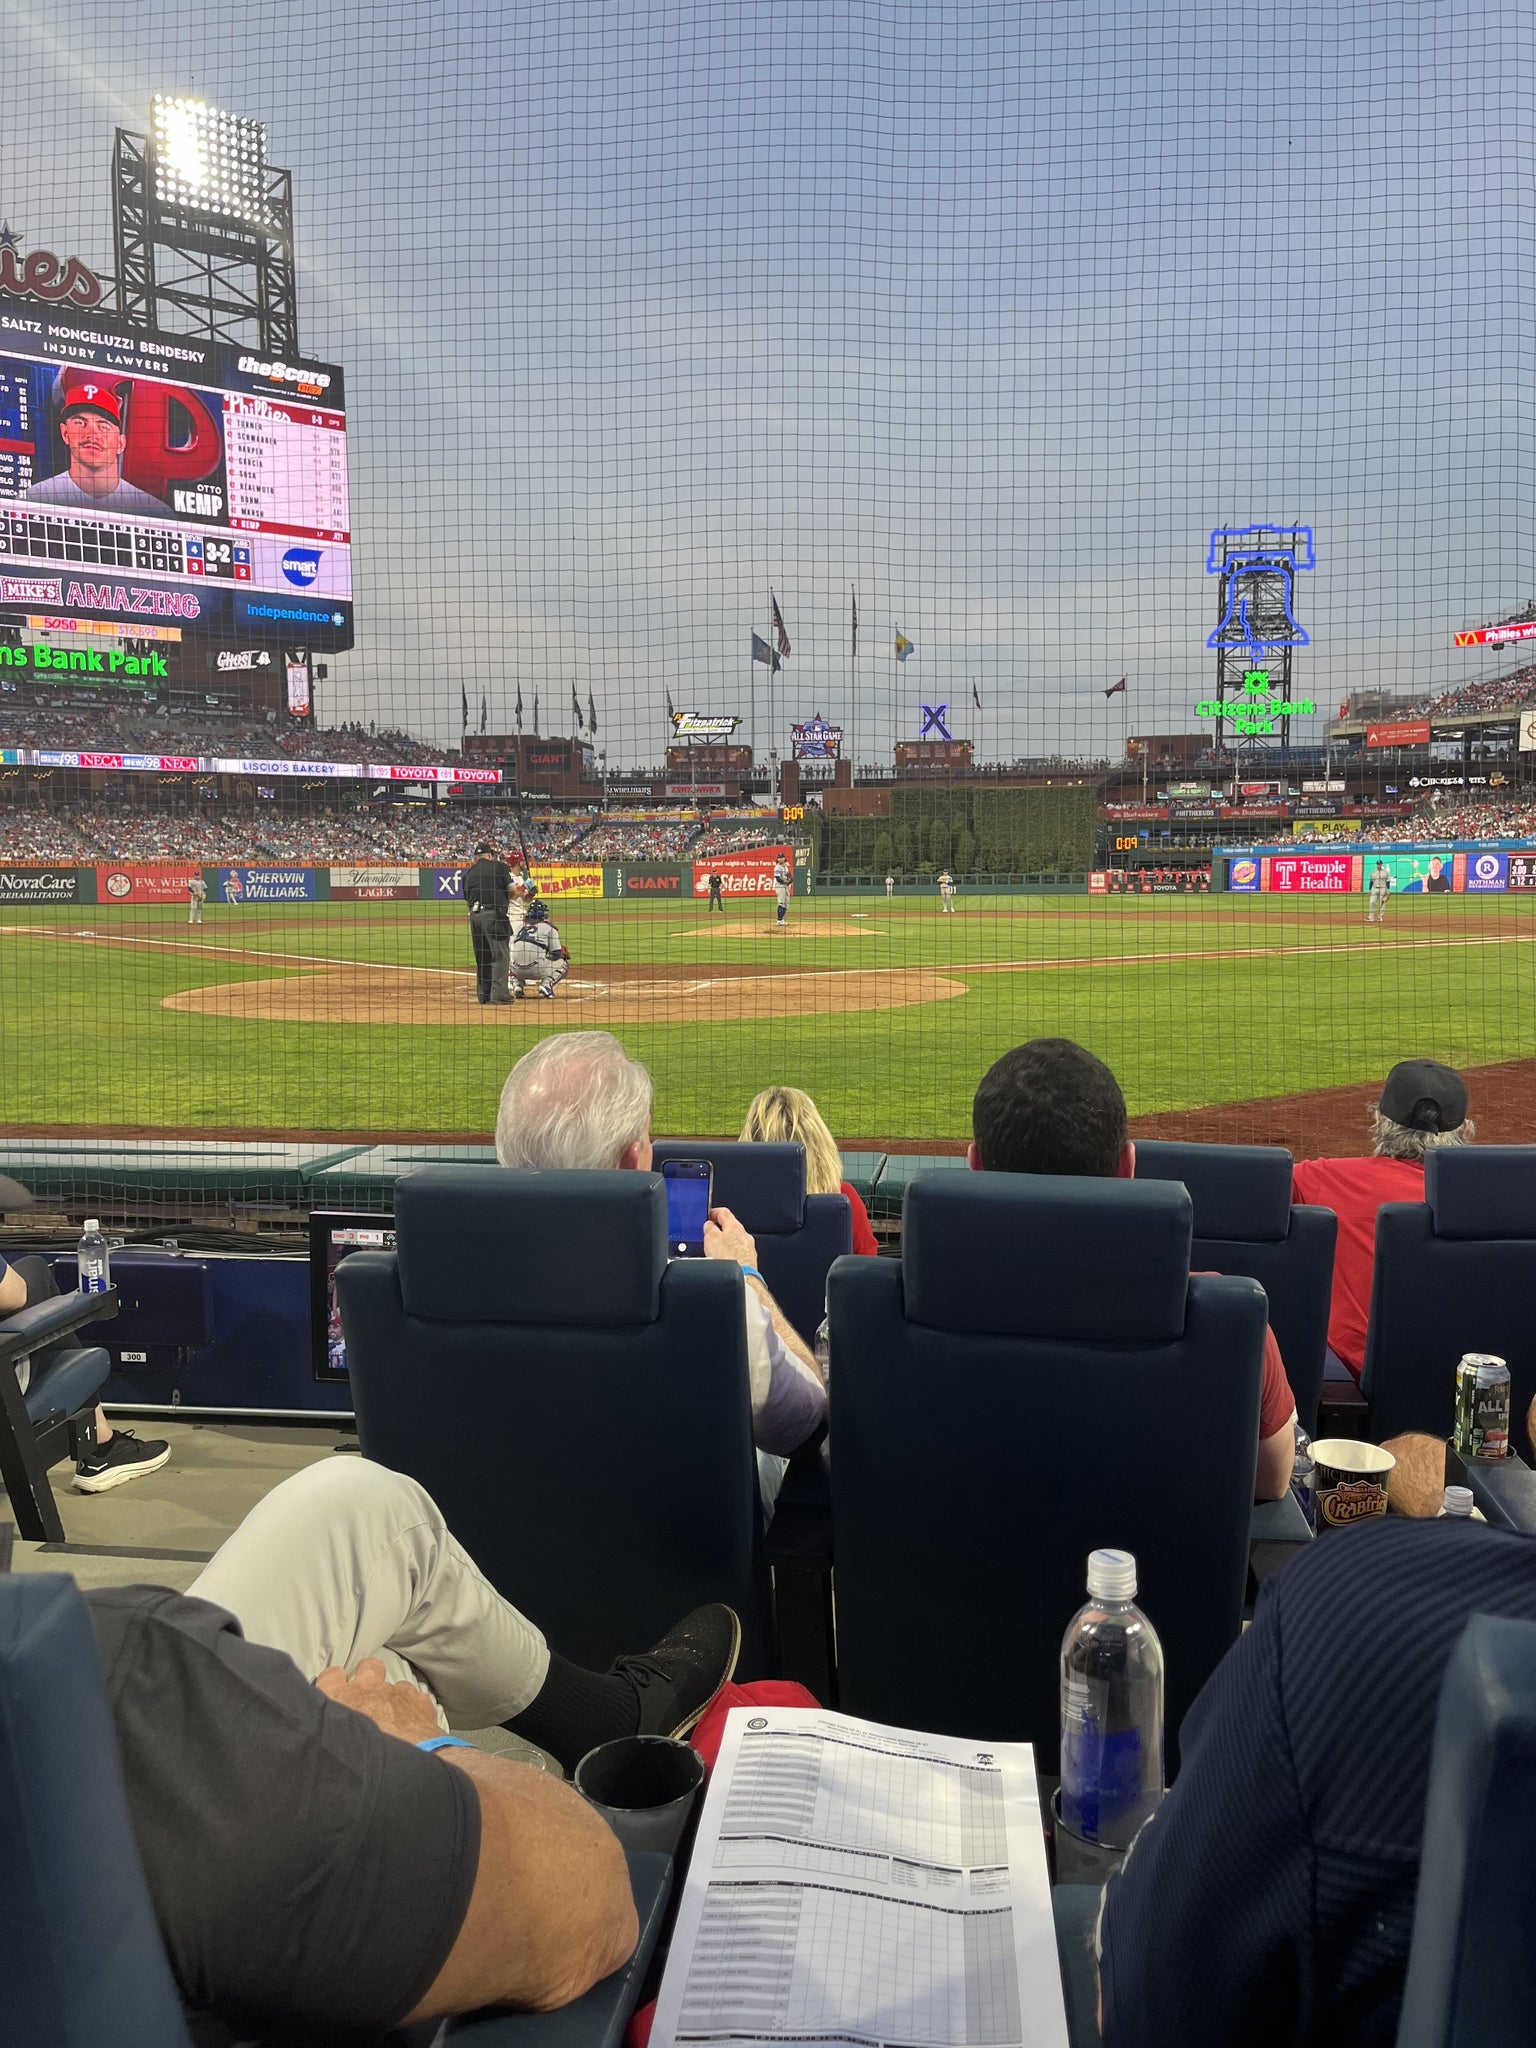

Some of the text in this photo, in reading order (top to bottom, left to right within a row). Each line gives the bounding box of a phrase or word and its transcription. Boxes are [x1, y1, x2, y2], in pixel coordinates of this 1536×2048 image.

[1, 316, 206, 363] SALTZ MONGELUZZI BENDESKY
[43, 341, 170, 373] INJURY LAWYERS
[237, 356, 331, 388] theScore
[197, 484, 222, 494] OTTO
[174, 490, 223, 517] KEMP
[241, 520, 260, 530] KEMP
[16, 524, 23, 533] 3
[139, 538, 146, 548] 3
[155, 541, 163, 550] 3
[172, 542, 179, 552] 0
[191, 545, 198, 555] 4
[206, 542, 231, 563] 3-2
[239, 550, 246, 561] 2
[141, 556, 146, 566] 1
[157, 558, 164, 568] 2
[173, 560, 179, 570] 1
[192, 562, 199, 571] 3
[282, 560, 317, 573] smart
[240, 568, 247, 577] 2
[8, 581, 200, 618] MIKE'S AMAZING
[247, 604, 330, 622] Independence
[1485, 627, 1521, 642] Phillies
[34, 643, 105, 672] Bank
[109, 650, 168, 677] Park
[217, 650, 260, 671] GHOST
[1196, 697, 1315, 717] Citizens Bank
[677, 713, 734, 729] Fitzpatrick
[1234, 718, 1274, 735] Park
[791, 730, 843, 741] ALL STAR GAME
[64, 754, 79, 764] 98
[82, 754, 117, 767] NECA
[163, 758, 197, 769] NECA
[529, 754, 568, 764] GIANT
[243, 762, 336, 774] LISCIO'S BAKERY
[394, 766, 436, 778] TOYOTA
[457, 770, 497, 780] TOYOTA
[528, 792, 551, 800] Fanatics
[783, 808, 805, 821] 0:09
[1241, 808, 1279, 816] Budweiser
[1322, 823, 1346, 832] PLAY
[1116, 837, 1138, 850] 0:09
[1300, 860, 1346, 877] Temple
[1483, 862, 1492, 873] R
[1511, 865, 1527, 875] 3.00
[1, 873, 76, 890] NovaCare
[246, 870, 305, 884] SHERWIN
[562, 874, 601, 891] MASON
[627, 877, 680, 889] GIANT
[1300, 876, 1343, 889] Health
[1516, 876, 1526, 885] 12
[0, 891, 74, 899] REHABILITATION
[358, 888, 394, 897] LAGER
[126, 1353, 142, 1361] 300
[1478, 1400, 1503, 1414] ALL
